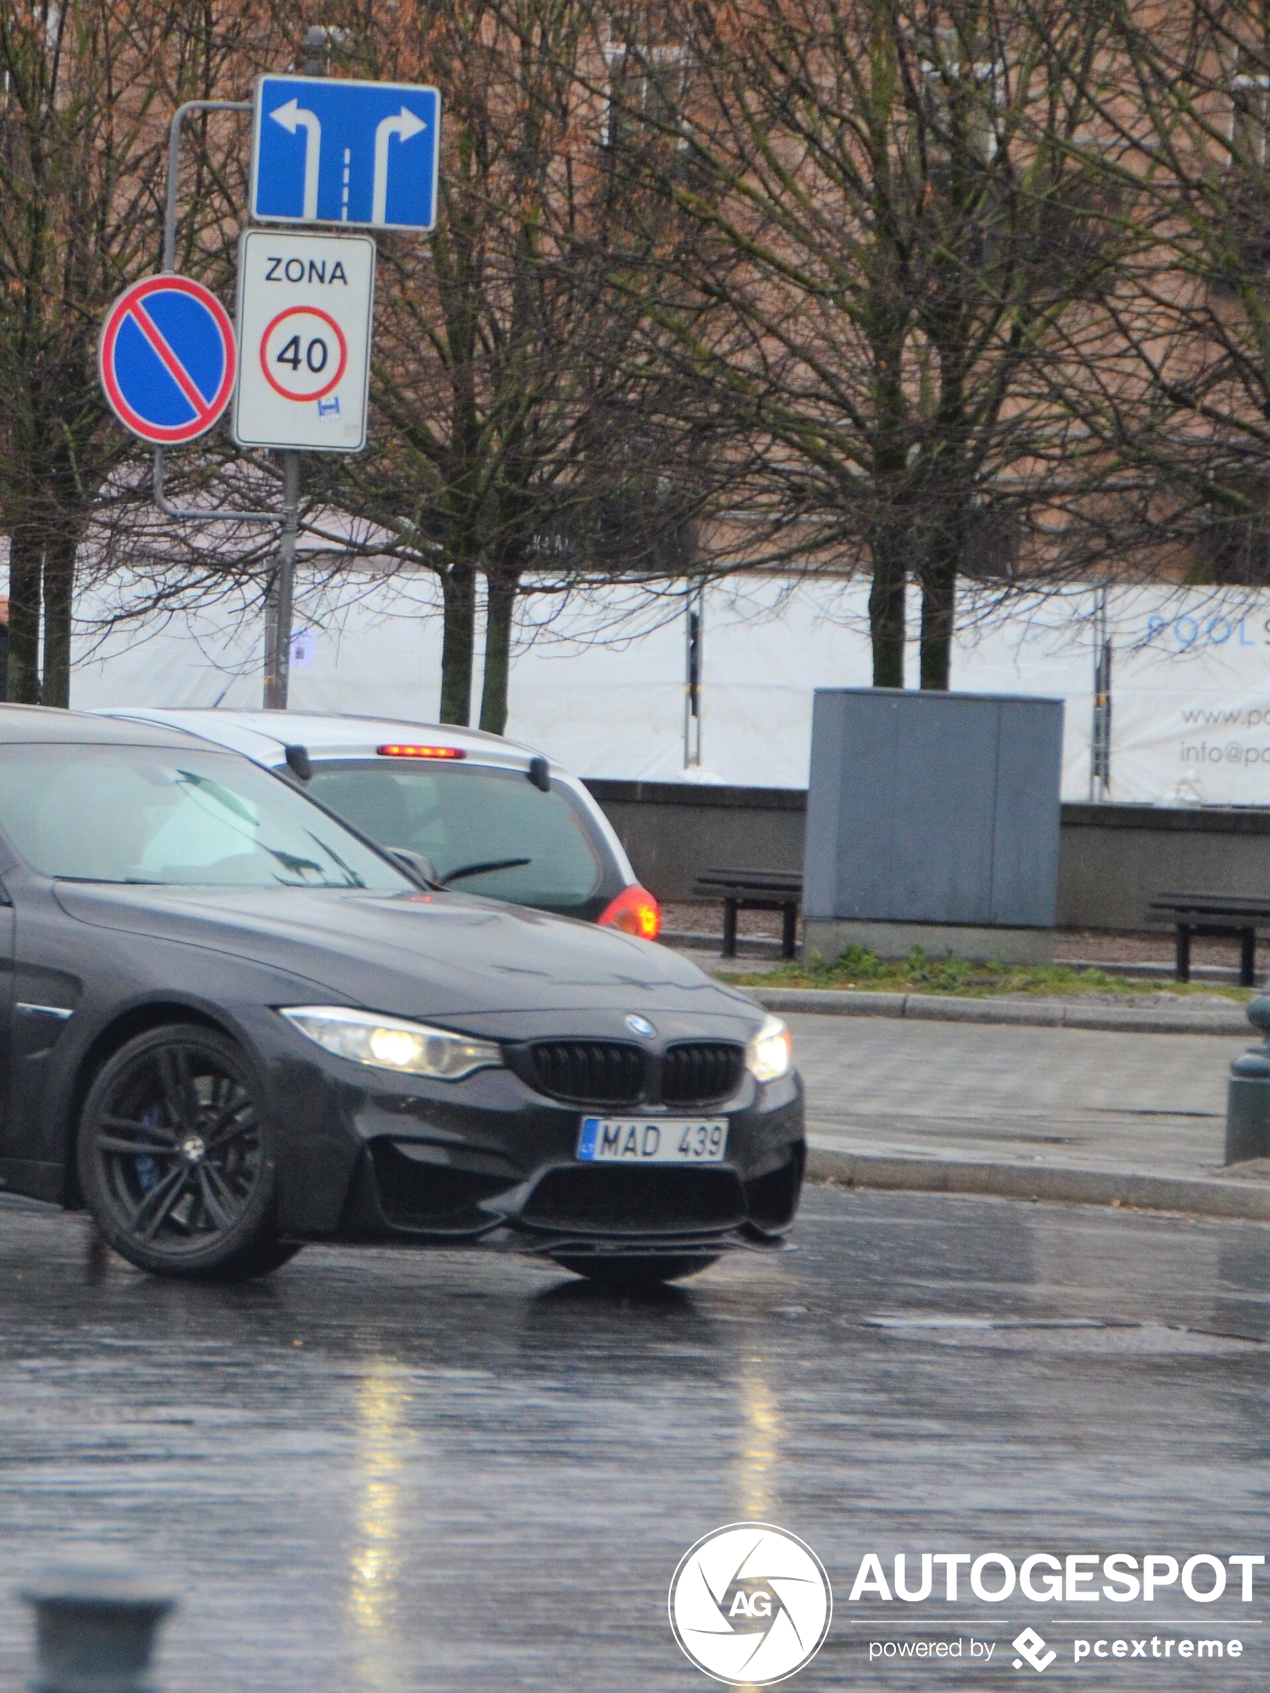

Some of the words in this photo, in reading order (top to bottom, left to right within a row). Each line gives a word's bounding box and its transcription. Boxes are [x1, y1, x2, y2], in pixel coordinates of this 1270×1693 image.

[265, 257, 348, 285] ZONA
[276, 335, 328, 373] 40
[1148, 615, 1255, 645] POOL
[600, 1124, 660, 1157] MAD
[678, 1125, 723, 1157] 439
